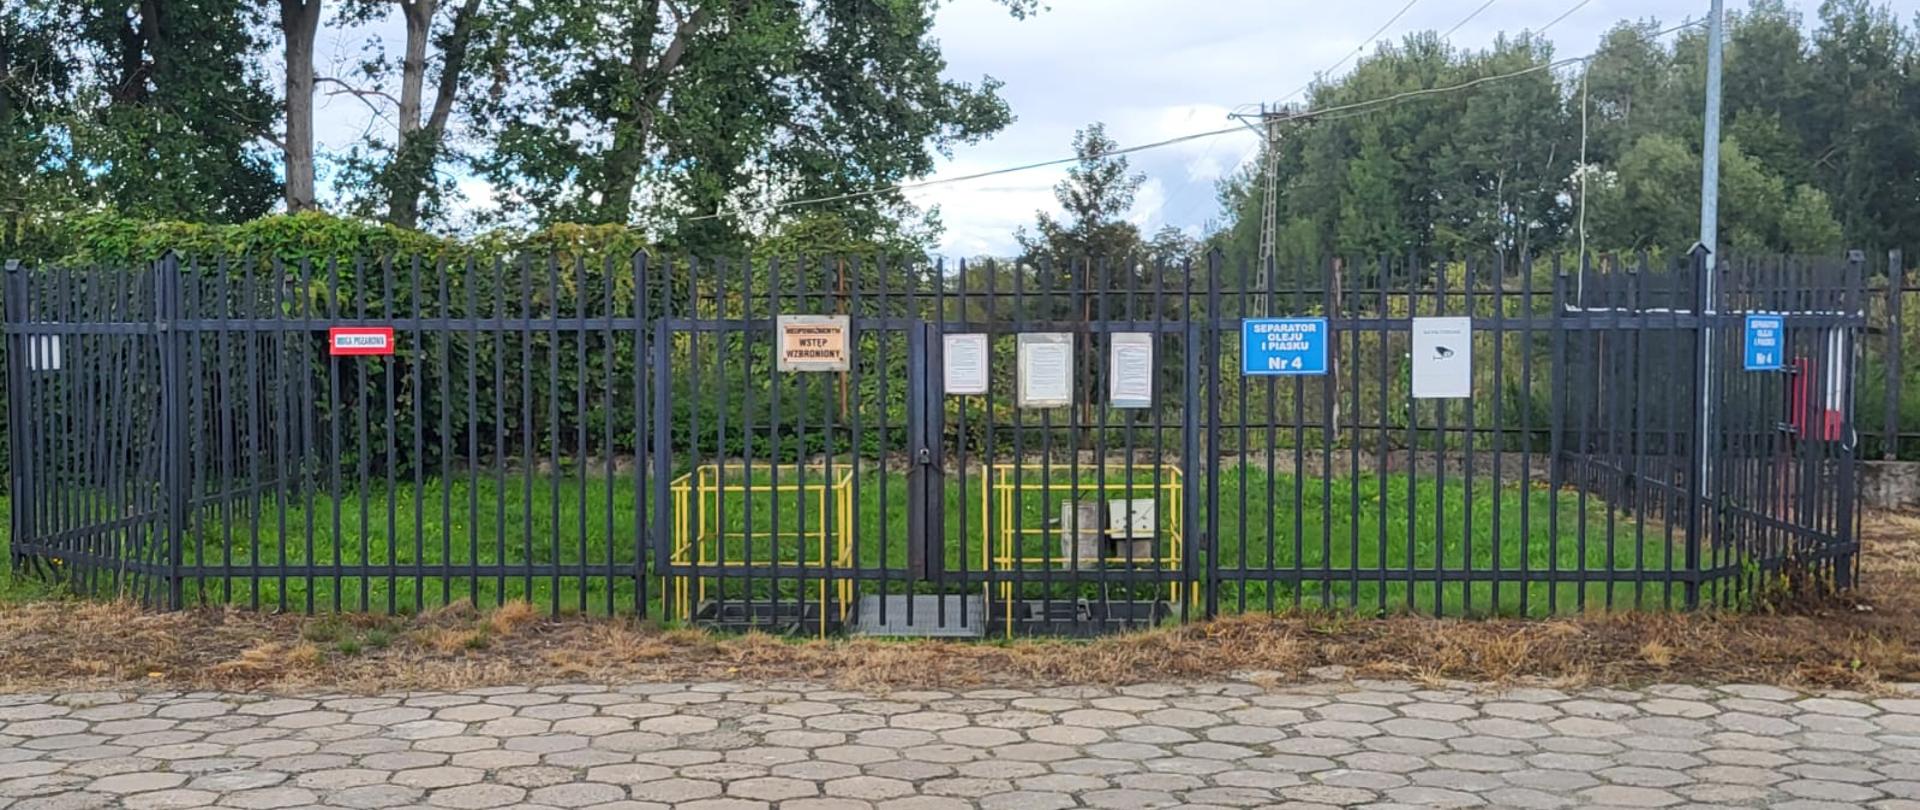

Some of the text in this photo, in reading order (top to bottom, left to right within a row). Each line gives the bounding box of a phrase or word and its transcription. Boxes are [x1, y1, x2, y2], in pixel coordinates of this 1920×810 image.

[1253, 323, 1317, 333] SEPARATOR
[1267, 333, 1303, 341] OLEJU
[799, 338, 829, 348] WSTĘP
[1261, 341, 1310, 351] I PIASKU
[786, 350, 841, 358] WZBRONIONY
[1268, 356, 1303, 369] Nr 4
